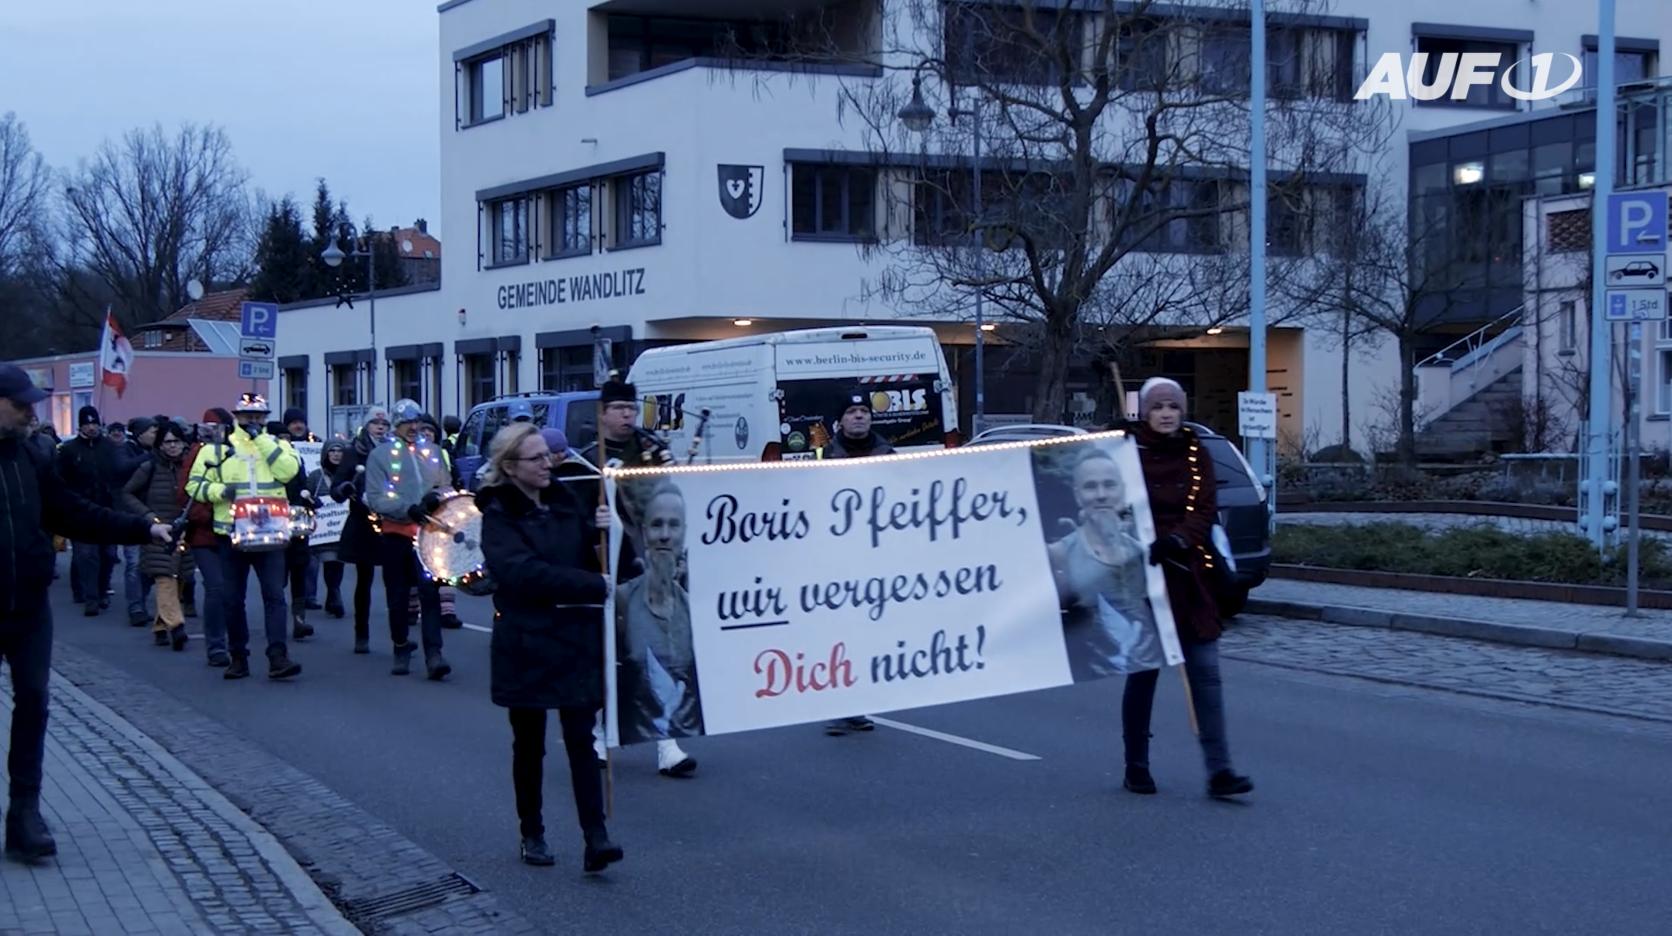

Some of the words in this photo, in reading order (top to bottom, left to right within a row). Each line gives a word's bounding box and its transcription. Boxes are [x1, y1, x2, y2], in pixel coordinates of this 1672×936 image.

[1620, 200, 1654, 246] P
[497, 278, 566, 310] GEMEINDE
[569, 267, 646, 301] WANDLITZ
[249, 306, 269, 334] P
[785, 350, 926, 366] www.berlin-bis-security.de
[315, 509, 350, 519] Spaltun
[326, 519, 341, 527] der
[700, 493, 810, 545] Boris
[829, 476, 1028, 548] Pfeiffer,
[717, 575, 788, 620] wir
[799, 563, 1003, 621] vergessen
[753, 641, 858, 698] Dich
[870, 624, 986, 683] nicht!
